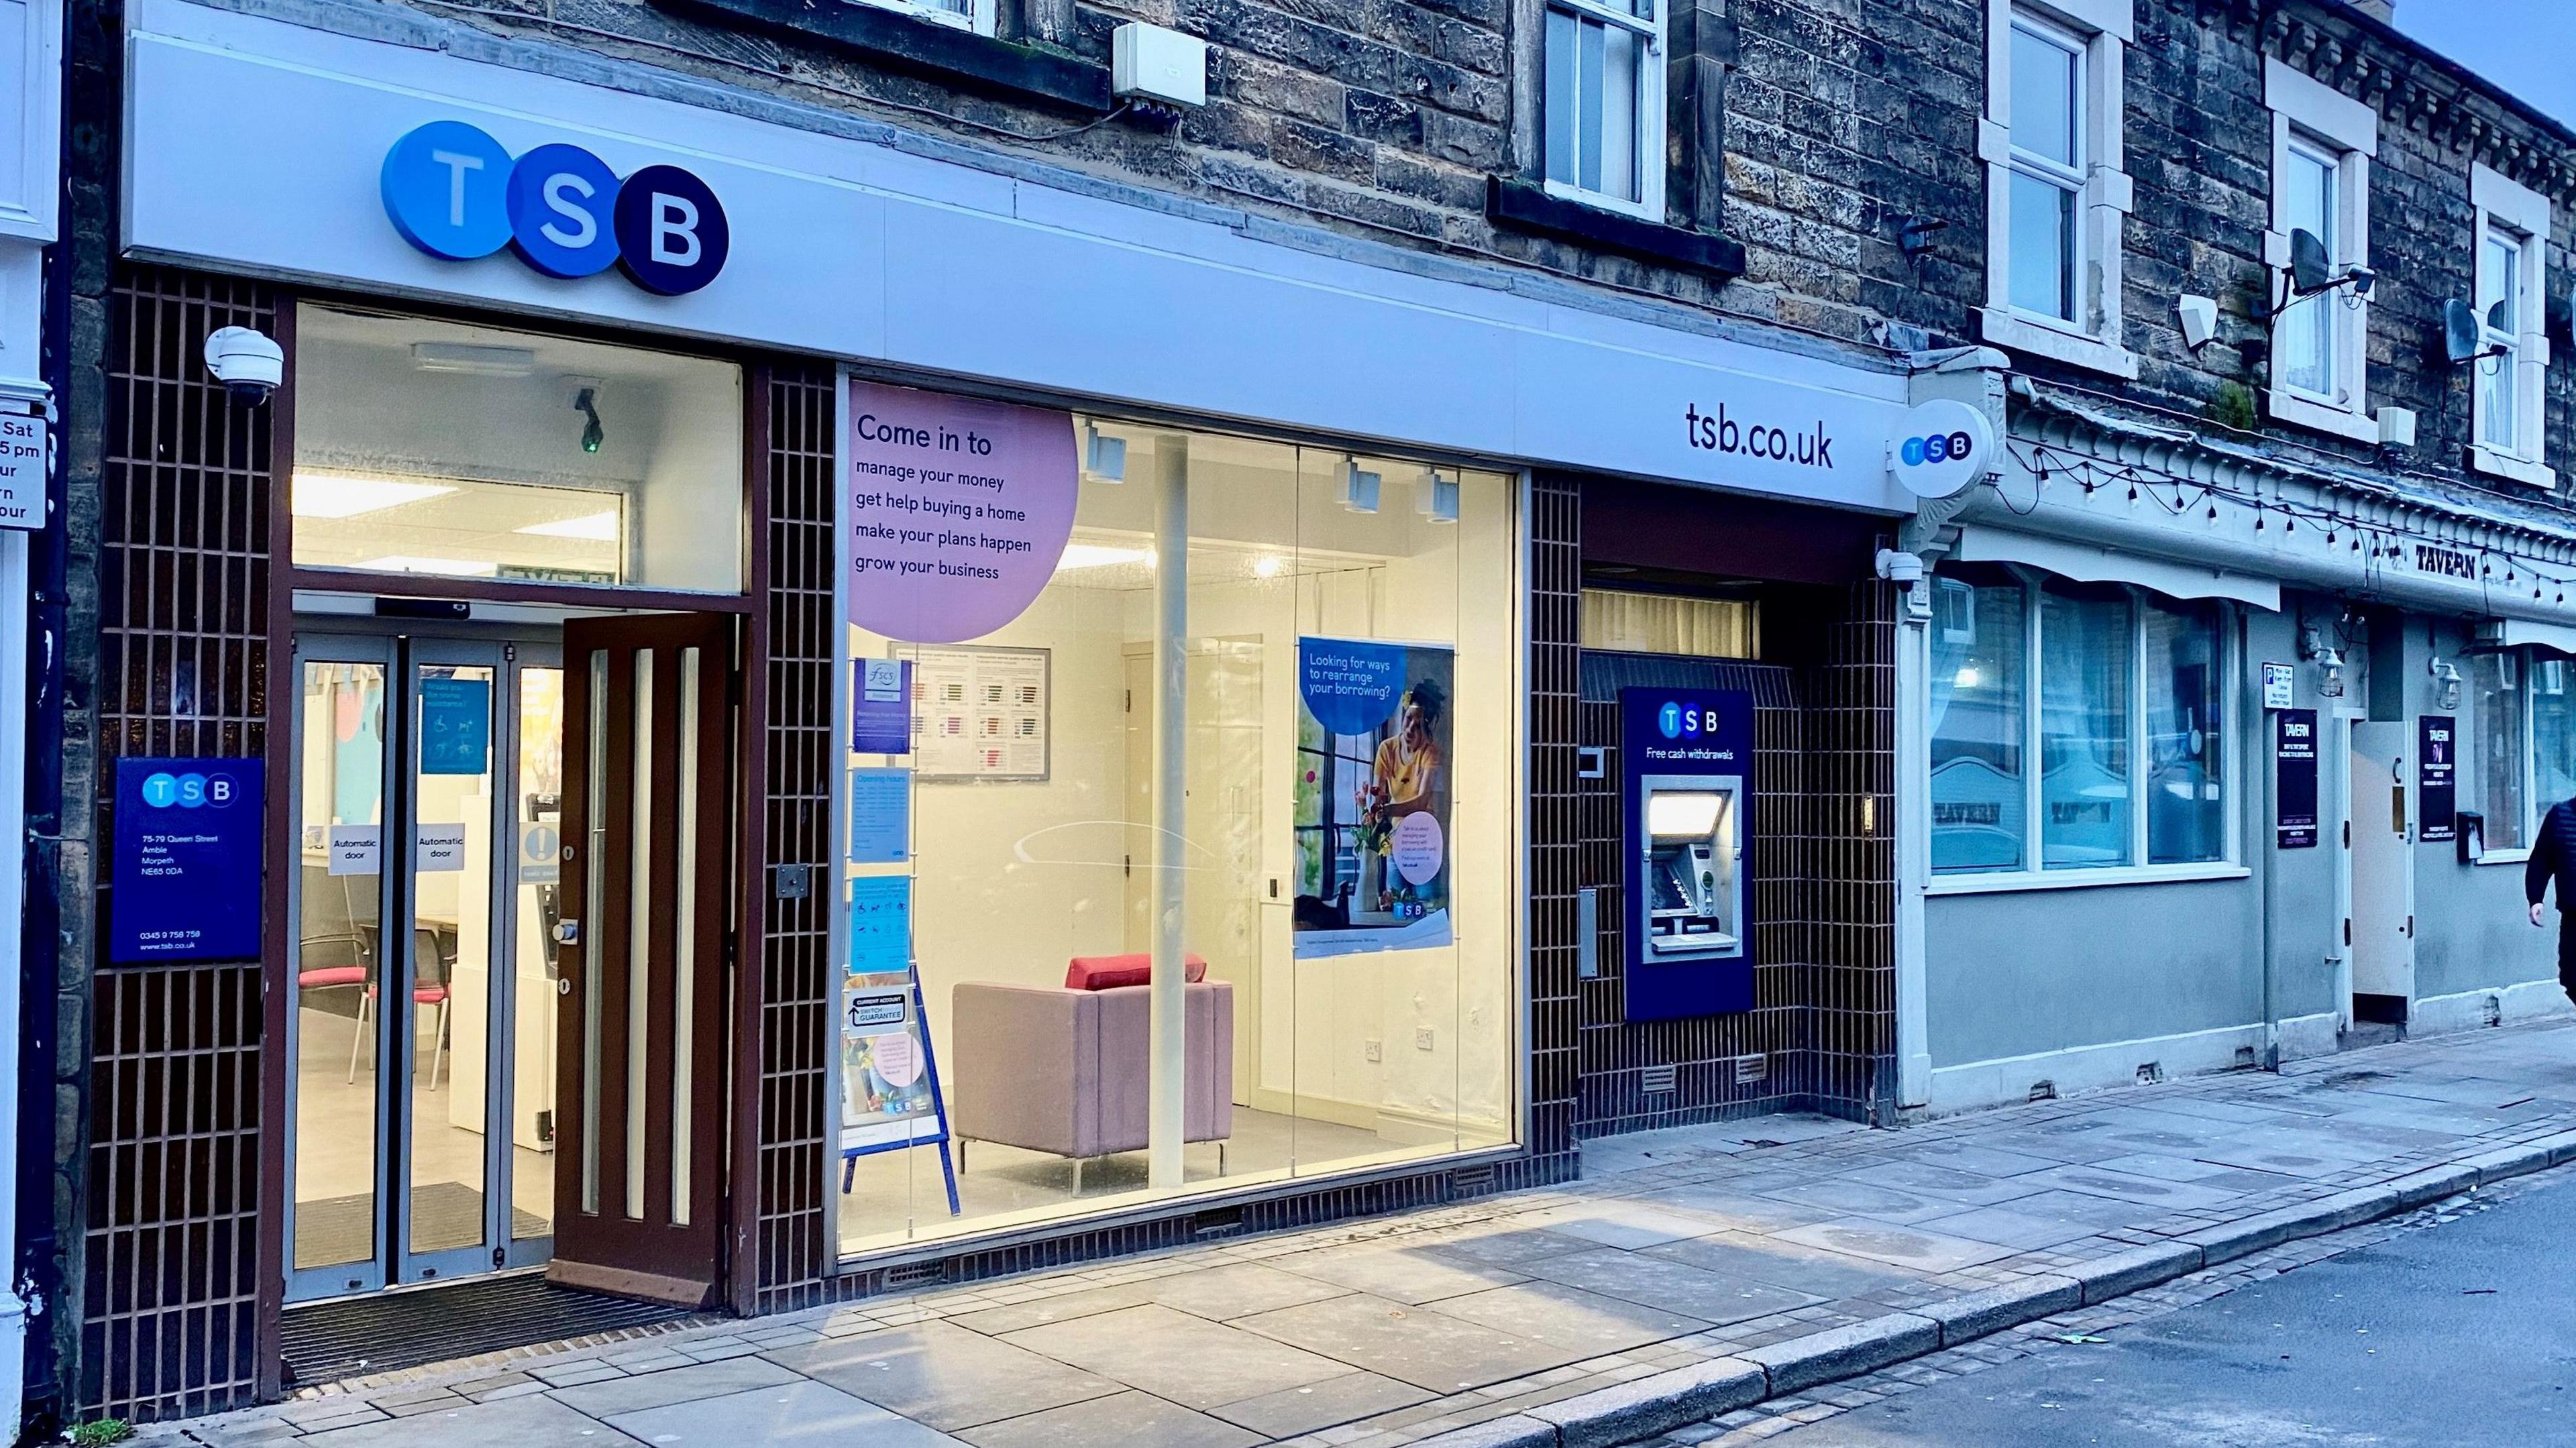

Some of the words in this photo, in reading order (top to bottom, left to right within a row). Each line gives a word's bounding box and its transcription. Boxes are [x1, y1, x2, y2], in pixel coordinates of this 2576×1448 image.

[431, 148, 702, 267] TSB
[3, 421, 34, 438] Sat
[857, 414, 930, 448] Come
[938, 425, 959, 452] in
[967, 431, 992, 456] to
[1685, 402, 1834, 469] tsb.co.uk
[14, 445, 40, 458] pm
[1908, 436, 1966, 460] TSB
[857, 461, 915, 482] manage
[919, 467, 954, 484] your
[957, 474, 1004, 493] money
[856, 492, 882, 508] get
[886, 492, 918, 514] help
[923, 496, 971, 520] buying
[975, 506, 983, 517] a
[987, 504, 1026, 521] home
[856, 522, 895, 539] make
[899, 529, 934, 545] your
[938, 530, 976, 548] plans
[980, 533, 1031, 554] happen
[855, 557, 896, 572] grow
[900, 559, 934, 575] your
[938, 559, 1000, 579] business
[2416, 544, 2475, 580] TAVERN
[1309, 653, 1348, 671] Looking
[1350, 656, 1365, 669] for
[1366, 661, 1390, 673] ways
[1309, 667, 1320, 679] to
[1322, 670, 1373, 685] rearrange
[1309, 683, 1333, 696] your
[1335, 682, 1391, 700] borrowing?
[1665, 709, 1717, 732] TSB
[2284, 723, 2310, 737] TAVERN
[1646, 746, 1666, 759] Free
[1668, 747, 1686, 759] cash
[1687, 748, 1734, 760] withdrawals
[857, 775, 885, 783] Opening
[886, 775, 906, 783] hours
[152, 780, 231, 801] TSB
[142, 835, 166, 843] 75-79
[333, 839, 377, 848] Automatic
[419, 837, 464, 846] Automatic
[142, 846, 168, 854] Amble
[430, 850, 451, 858] door
[142, 856, 174, 866] Morpeth
[1396, 905, 1421, 915] TSB
[140, 932, 160, 940] 0345
[162, 931, 168, 939] 9
[169, 930, 184, 938] 758
[140, 941, 196, 950] www.tsb.co.uk
[859, 1011, 901, 1021] GUARANTEE
